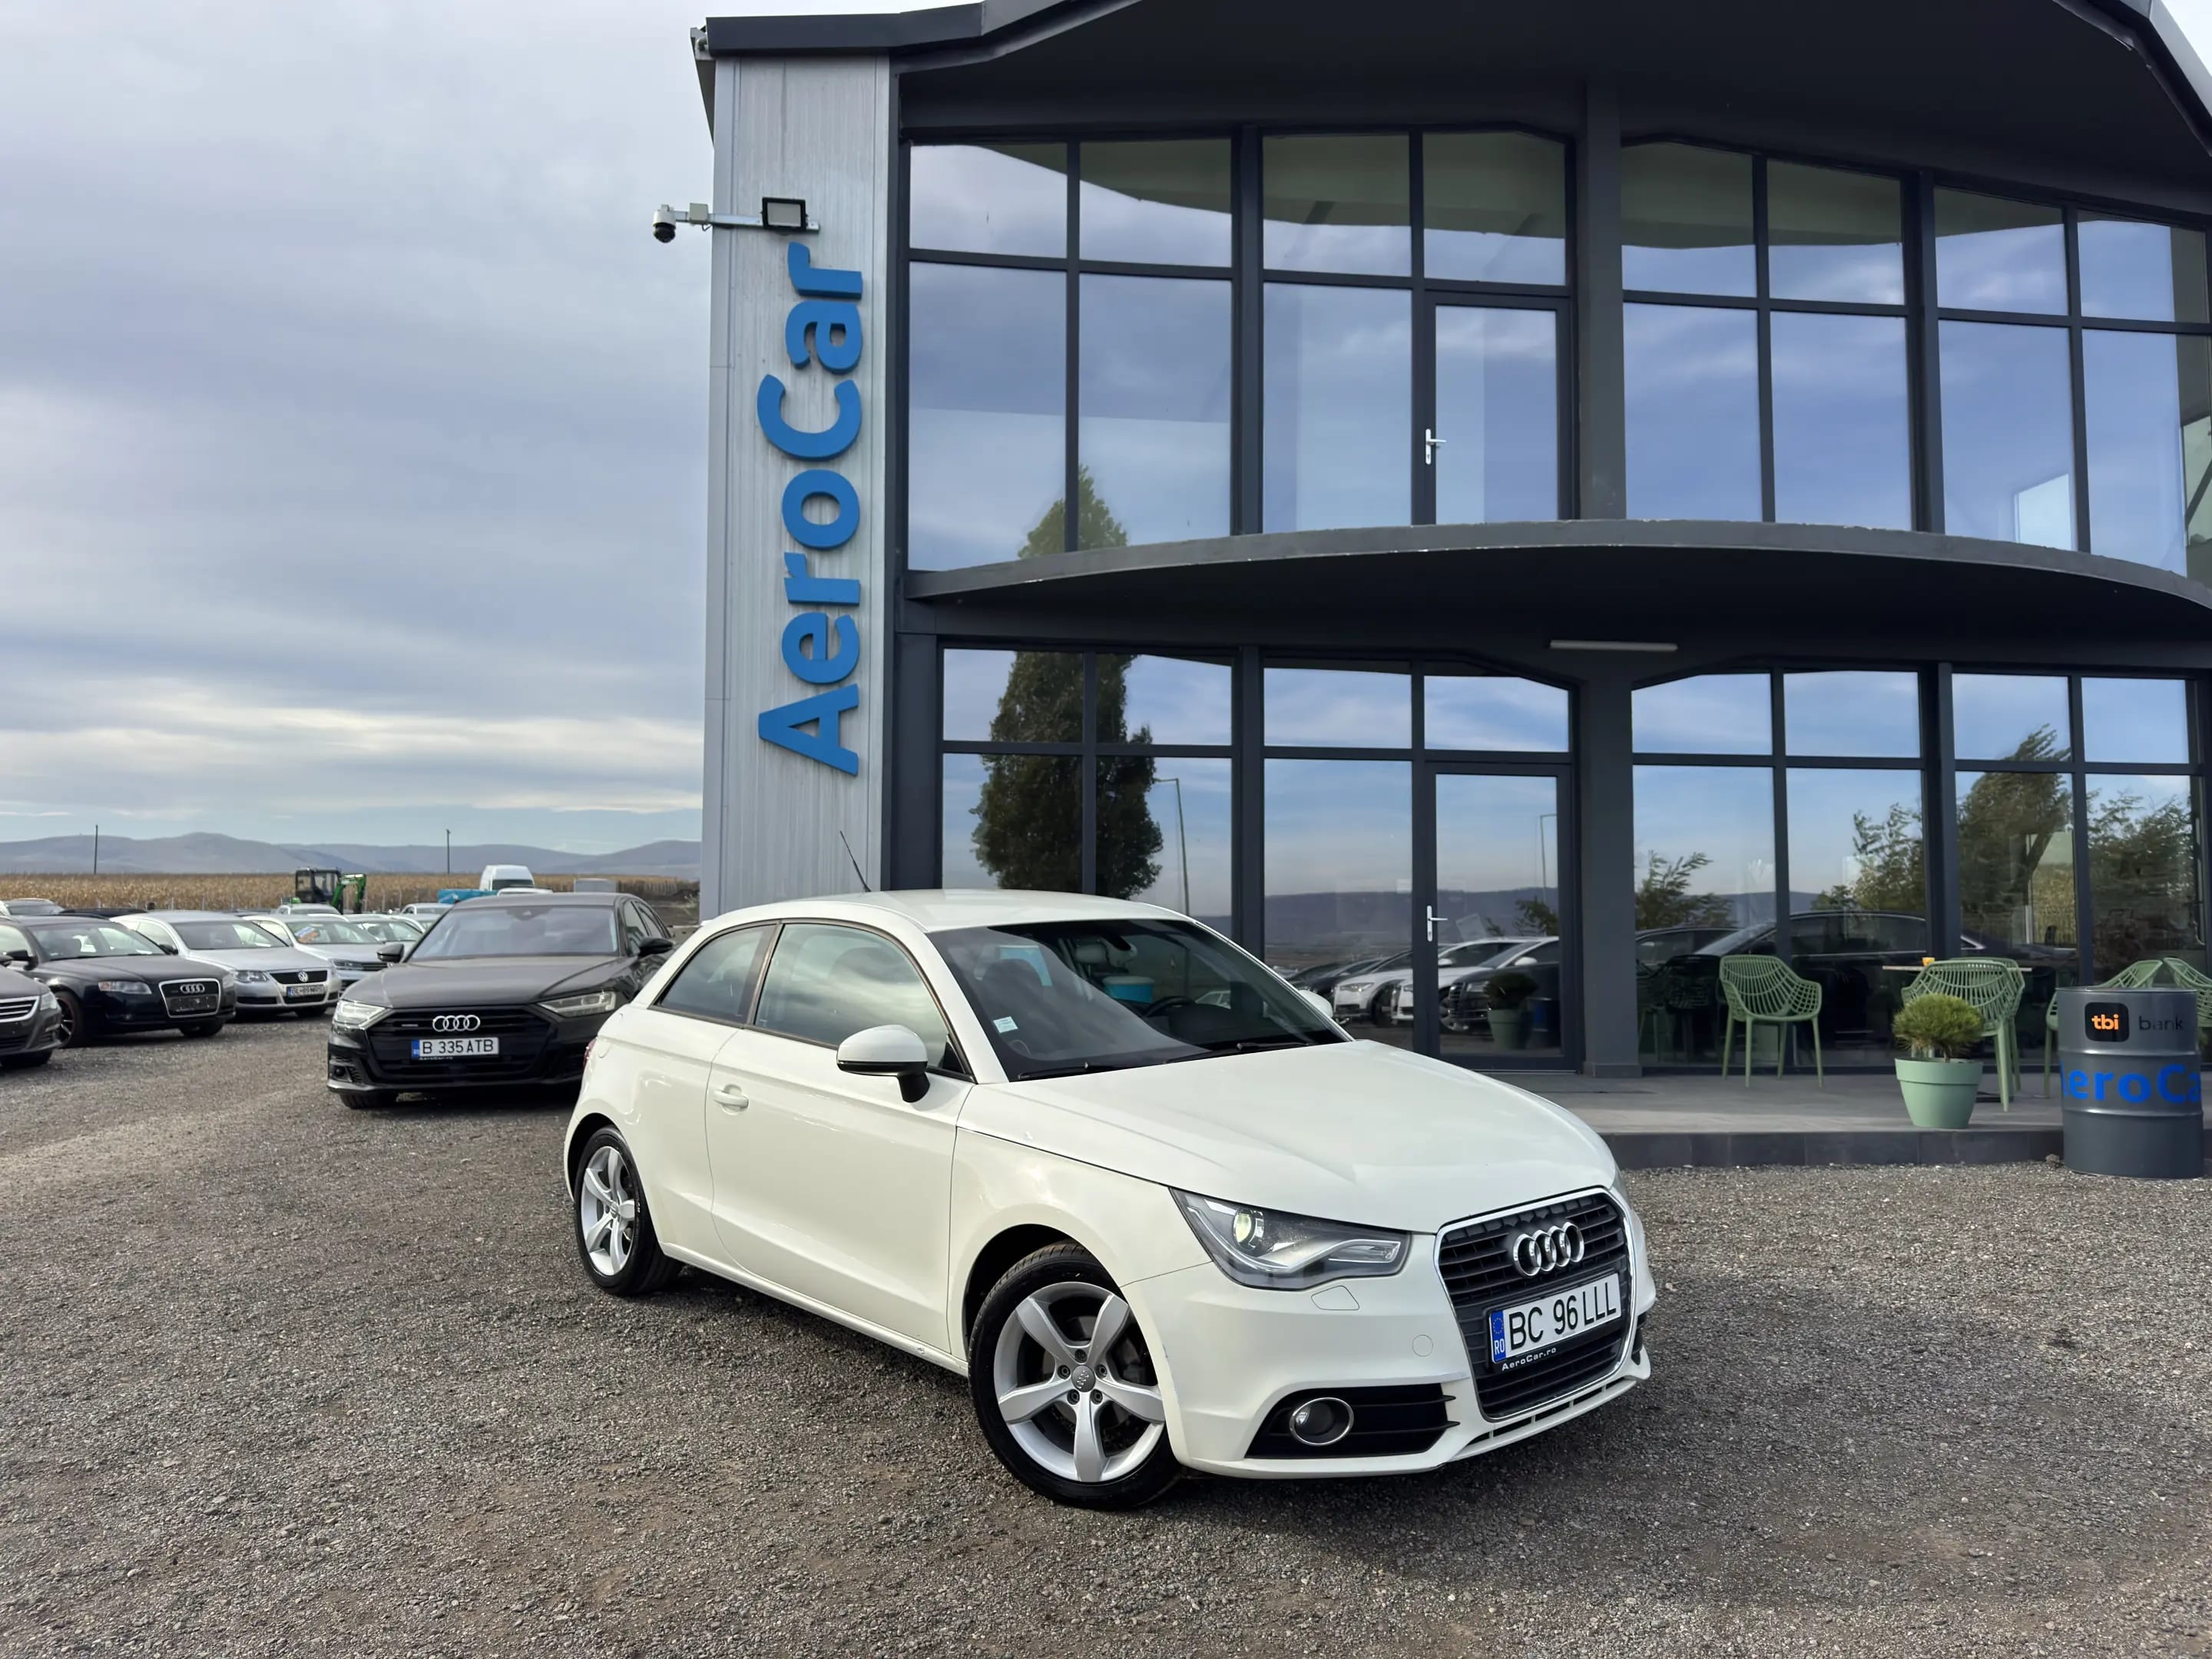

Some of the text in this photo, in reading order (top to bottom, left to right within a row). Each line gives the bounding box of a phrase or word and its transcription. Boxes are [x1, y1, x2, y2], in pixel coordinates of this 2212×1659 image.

[757, 241, 863, 777] AeroCar
[2091, 1013, 2183, 1031] tbi bank
[422, 1041, 432, 1055] B
[439, 1040, 464, 1053] 335
[466, 1038, 493, 1052] ATB
[1509, 1282, 1617, 1350] BC 96 LLL
[1494, 1339, 1505, 1355] RO
[1502, 1347, 1557, 1371] AeroCar.ro
